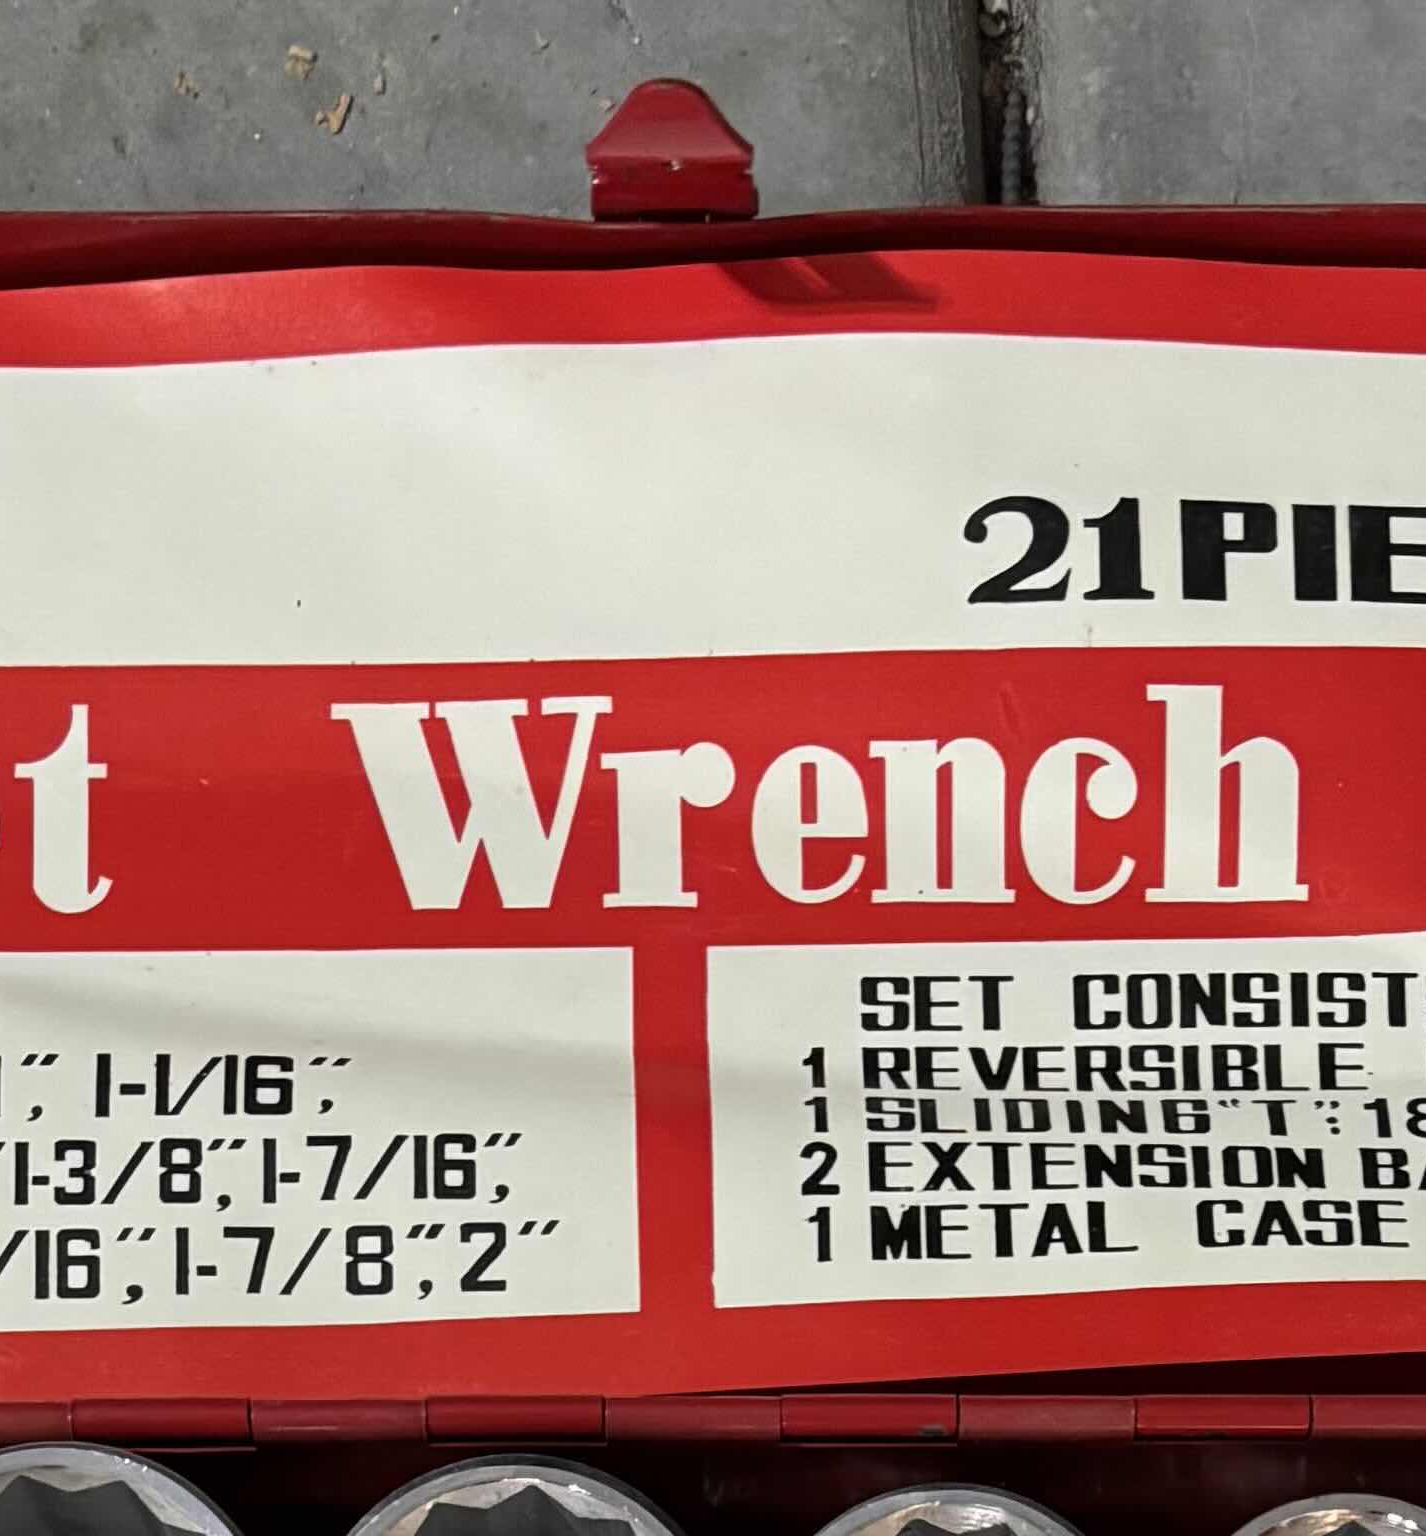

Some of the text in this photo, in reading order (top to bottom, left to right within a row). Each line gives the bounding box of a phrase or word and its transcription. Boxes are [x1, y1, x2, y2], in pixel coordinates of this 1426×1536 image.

[962, 494, 1156, 605] 21
[330, 684, 1311, 910] Wrench
[859, 974, 1015, 1033] SET
[801, 1045, 827, 1090] 1
[860, 1041, 1370, 1093] REVERSIBLE
[803, 1095, 830, 1134] 1
[798, 1140, 842, 1197] 2
[866, 1140, 1328, 1194] EXTENSION
[806, 1198, 1411, 1264] 1 METAL CASE
